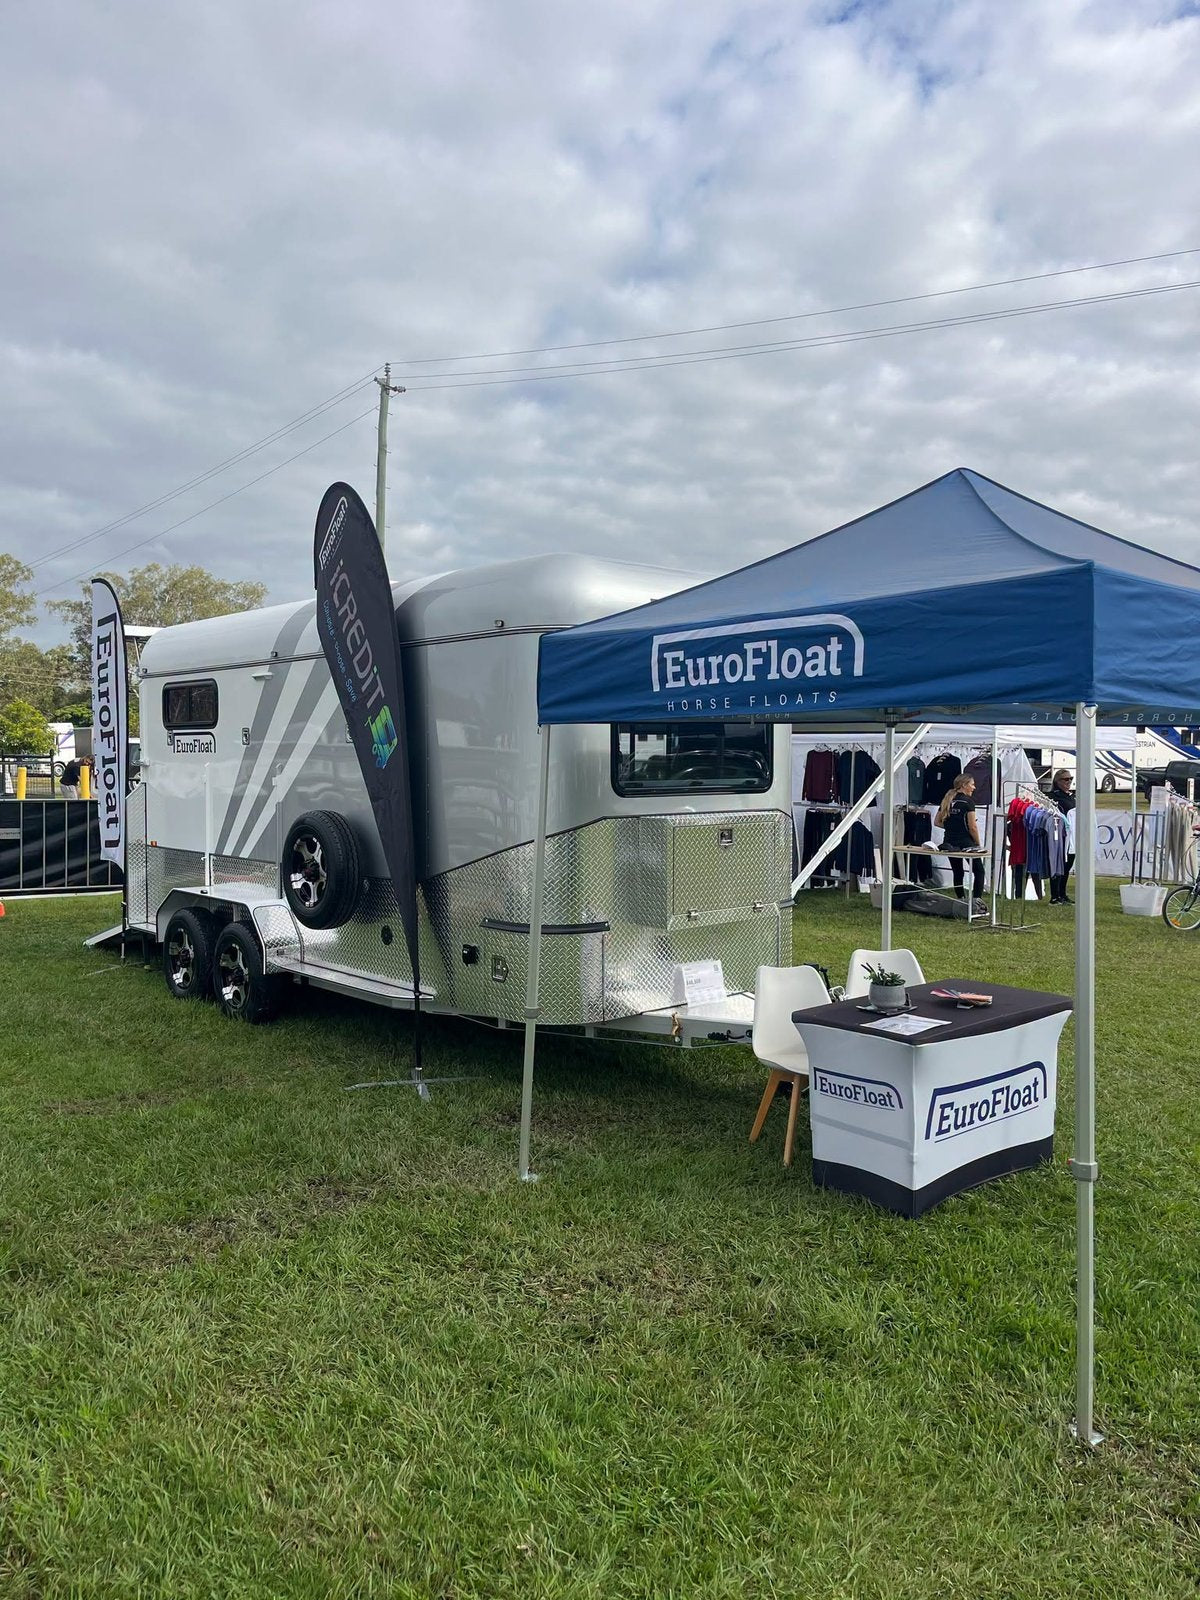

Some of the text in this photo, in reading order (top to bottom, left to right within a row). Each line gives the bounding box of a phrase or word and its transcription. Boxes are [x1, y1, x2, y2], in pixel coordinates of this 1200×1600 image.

[663, 636, 843, 688] EuroFloat
[667, 691, 837, 711] HORSE FLOATS
[96, 631, 120, 829] EuroFloat
[176, 739, 213, 753] EuroFloat
[1103, 848, 1166, 864] WATE
[819, 1076, 895, 1108] EuroFloat
[935, 1076, 1040, 1137] EuroFloat
